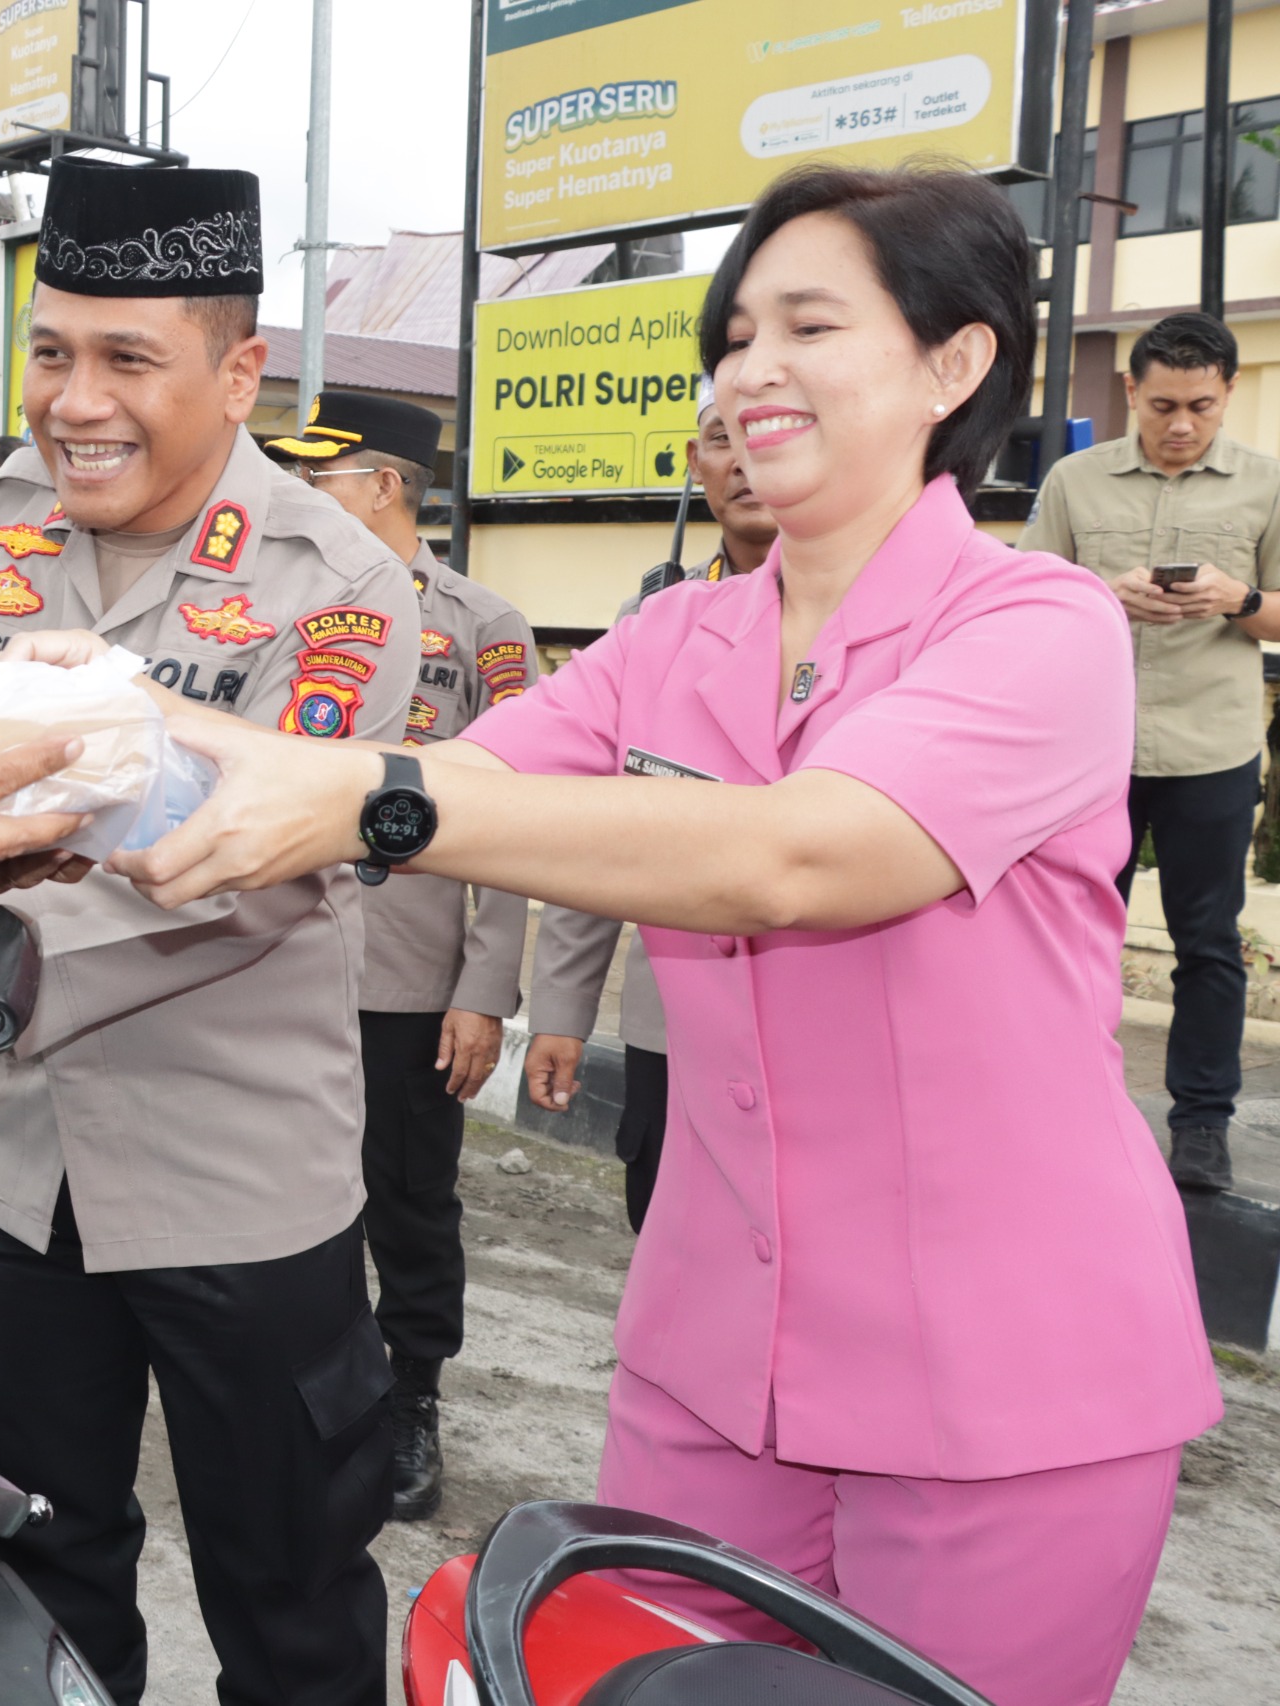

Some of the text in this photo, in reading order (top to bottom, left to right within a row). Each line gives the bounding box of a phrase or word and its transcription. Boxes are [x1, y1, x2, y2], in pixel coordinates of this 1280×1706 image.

[900, 0, 1004, 29] Telkomse
[811, 71, 913, 99] Aktifkan sekarang di
[922, 90, 960, 106] Outlet
[505, 83, 676, 148] SUPER SERU
[914, 102, 967, 121] Terdekat
[505, 130, 667, 179] Super Kuotanya
[503, 162, 673, 210] Super Hematnya
[497, 315, 621, 353] Download
[495, 371, 702, 416] POLRI Super
[534, 443, 586, 455] TEMUKAN DI
[533, 458, 624, 484] Google Play
[306, 613, 382, 634] POLRES
[310, 625, 381, 642] PEMATANG SIANTAR
[477, 645, 523, 667] POLRES
[143, 657, 249, 705] OLRI
[419, 662, 458, 689] LRI
[625, 754, 642, 771] NY.
[383, 821, 418, 837] 16:43
